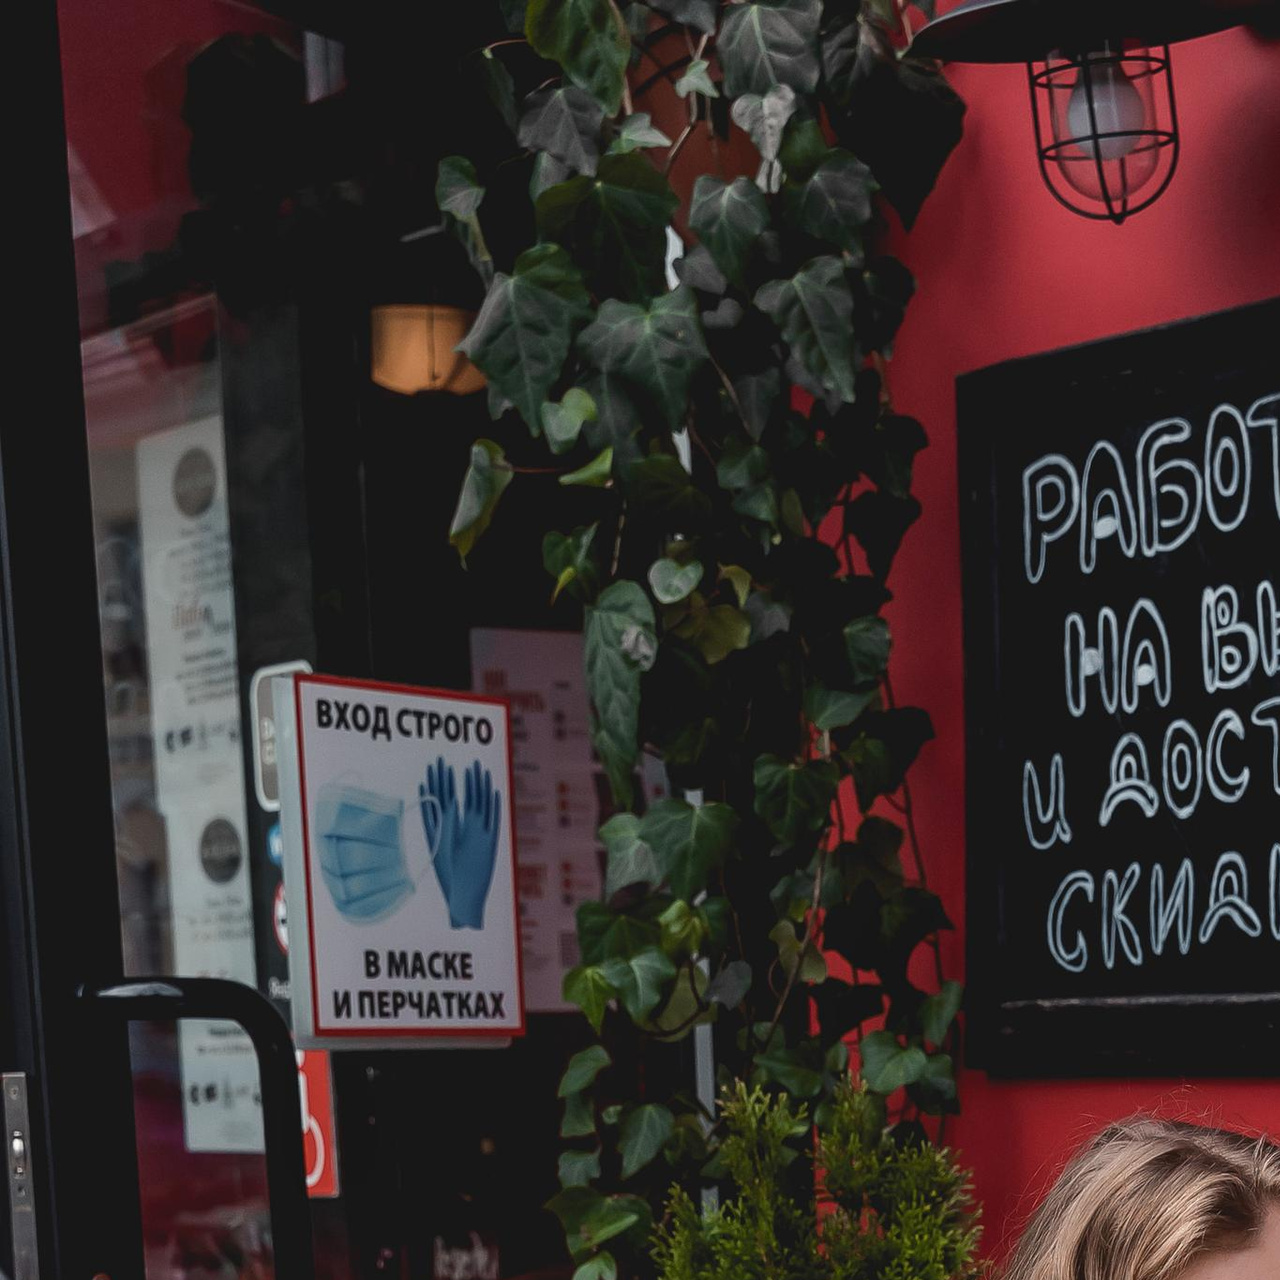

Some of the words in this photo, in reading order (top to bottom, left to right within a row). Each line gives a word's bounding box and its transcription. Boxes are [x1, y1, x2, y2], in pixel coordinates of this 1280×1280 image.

[1065, 598, 1172, 717] НА
[316, 698, 392, 742] ВХОД
[396, 707, 493, 746] СТРОГО
[363, 950, 381, 979] В
[387, 950, 474, 980] МАСКЕ
[333, 990, 351, 1018] И
[358, 990, 505, 1019] ПЕРЧАТКАХ
